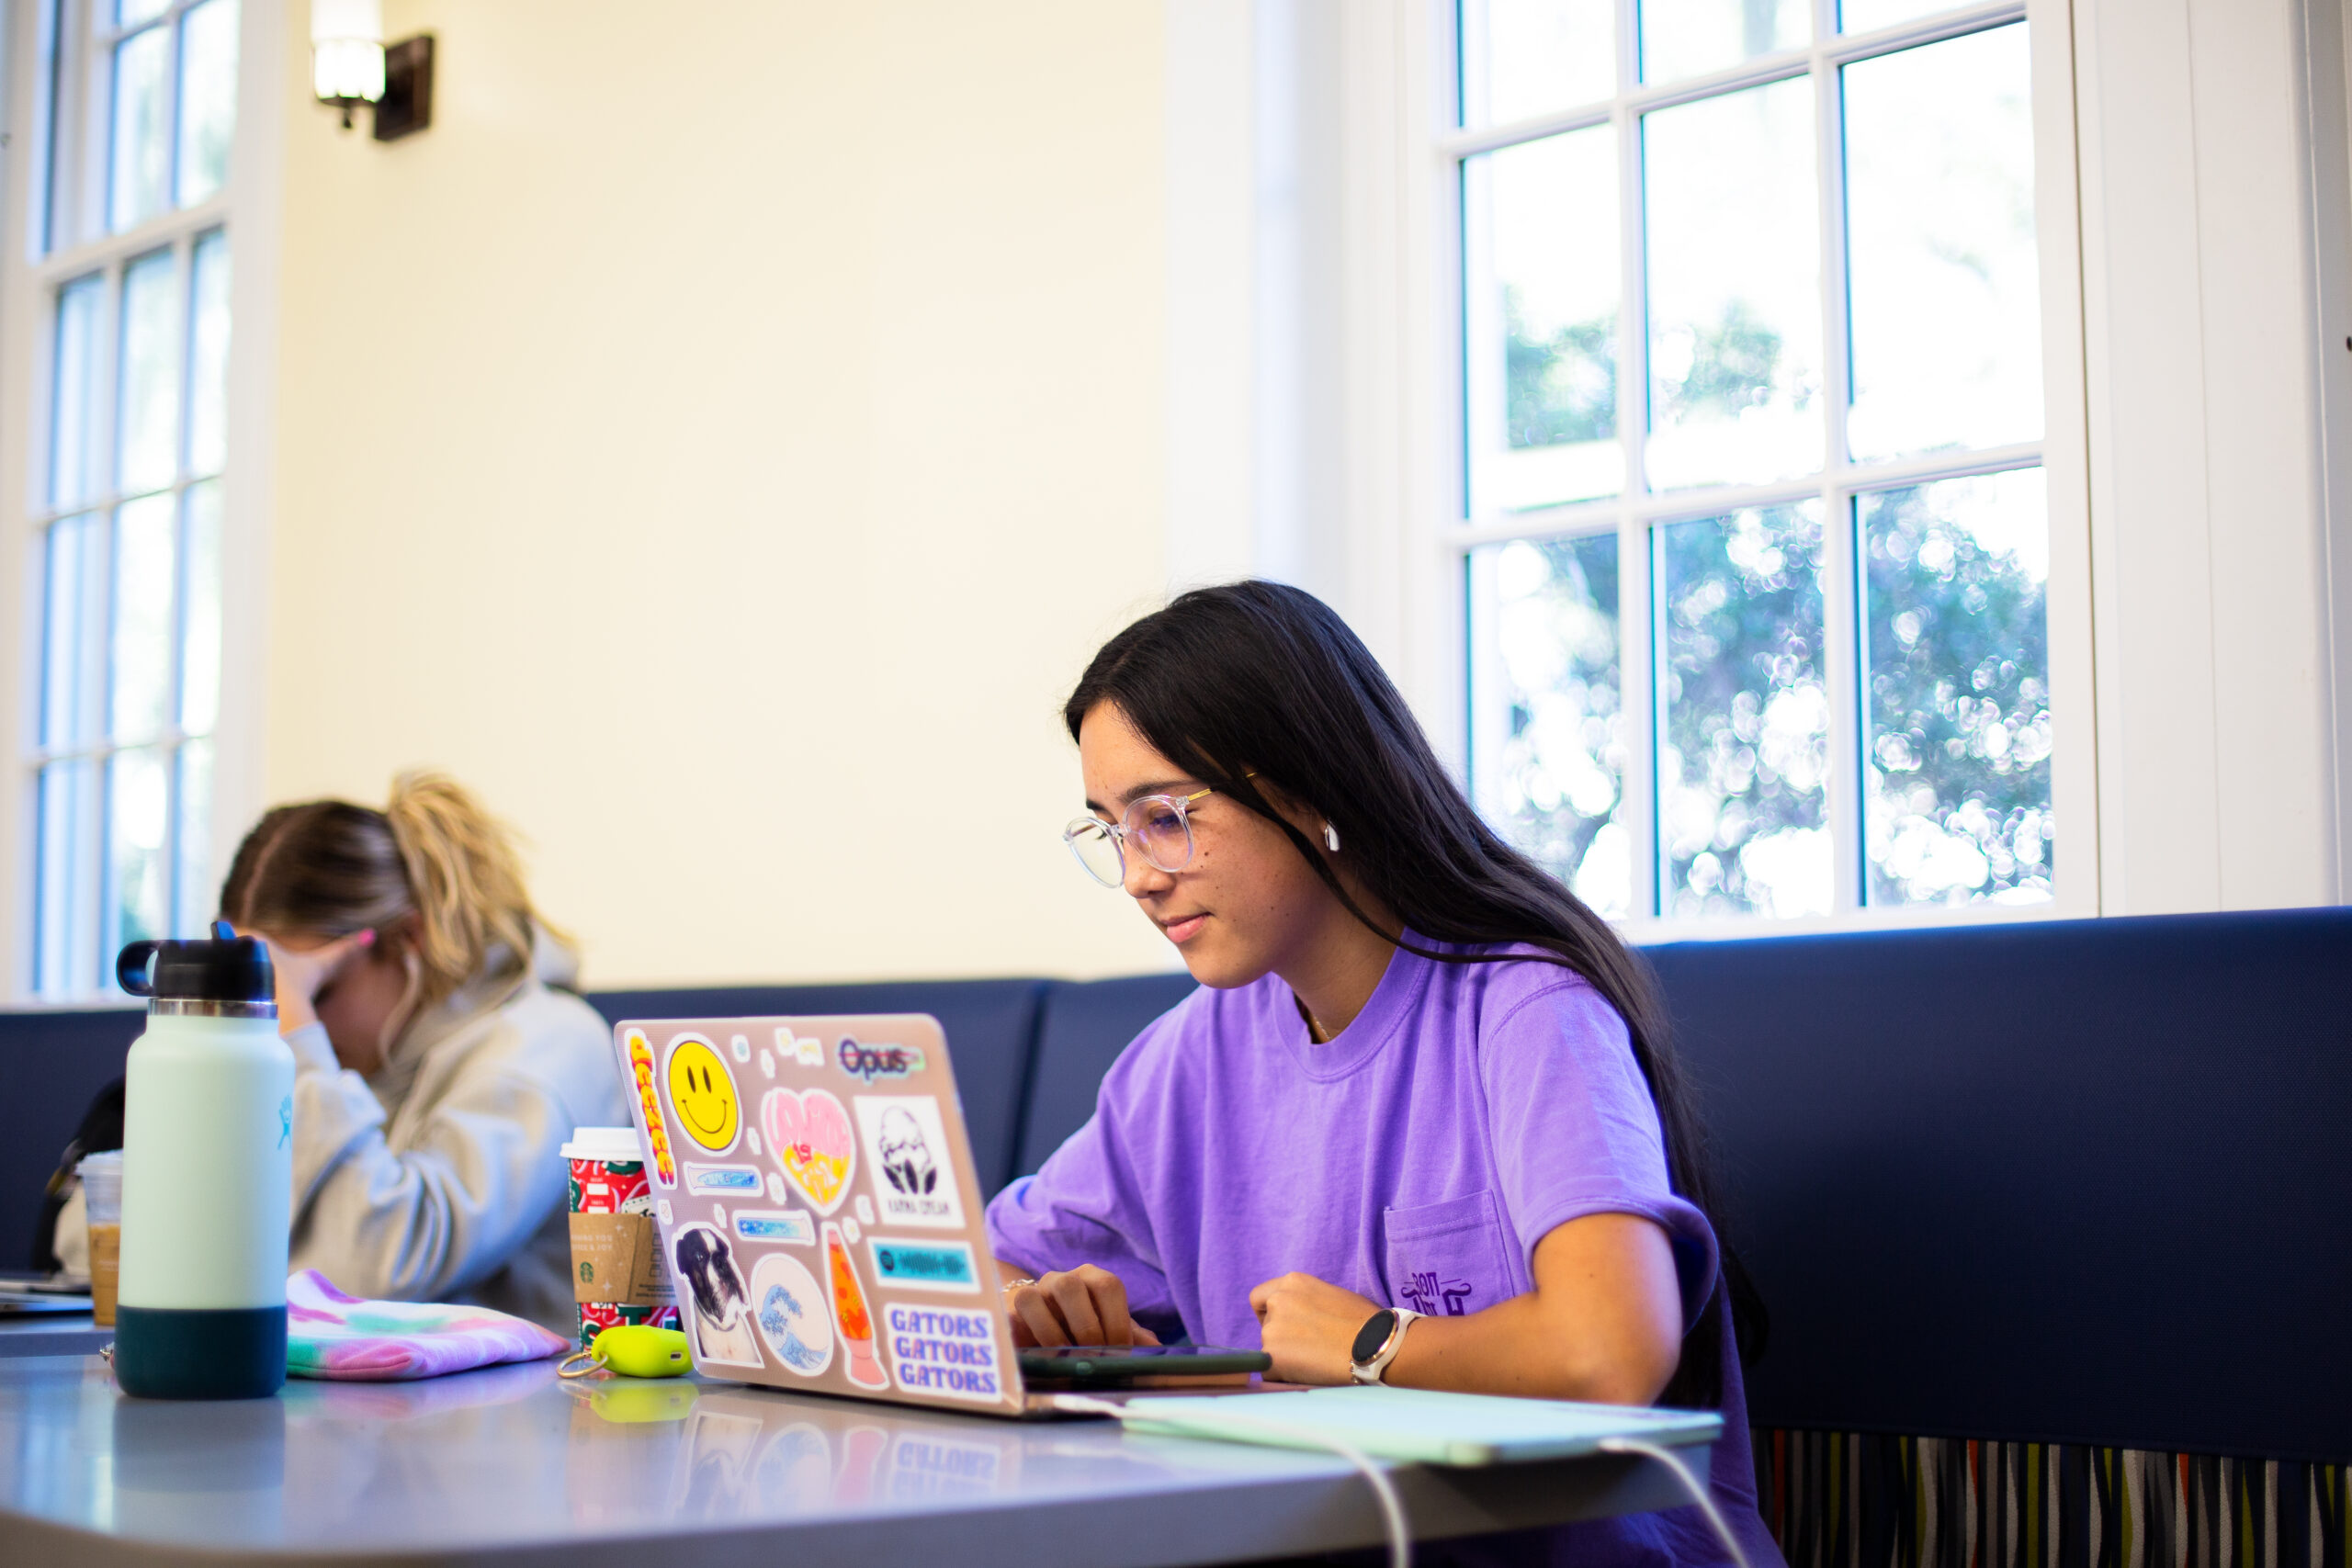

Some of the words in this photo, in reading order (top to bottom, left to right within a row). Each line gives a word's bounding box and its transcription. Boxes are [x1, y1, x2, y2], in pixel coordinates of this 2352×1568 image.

[839, 1039, 907, 1080] Opus
[890, 1309, 989, 1339] GATORS
[894, 1336, 993, 1367] GATORS
[899, 1363, 997, 1394] GATORS
